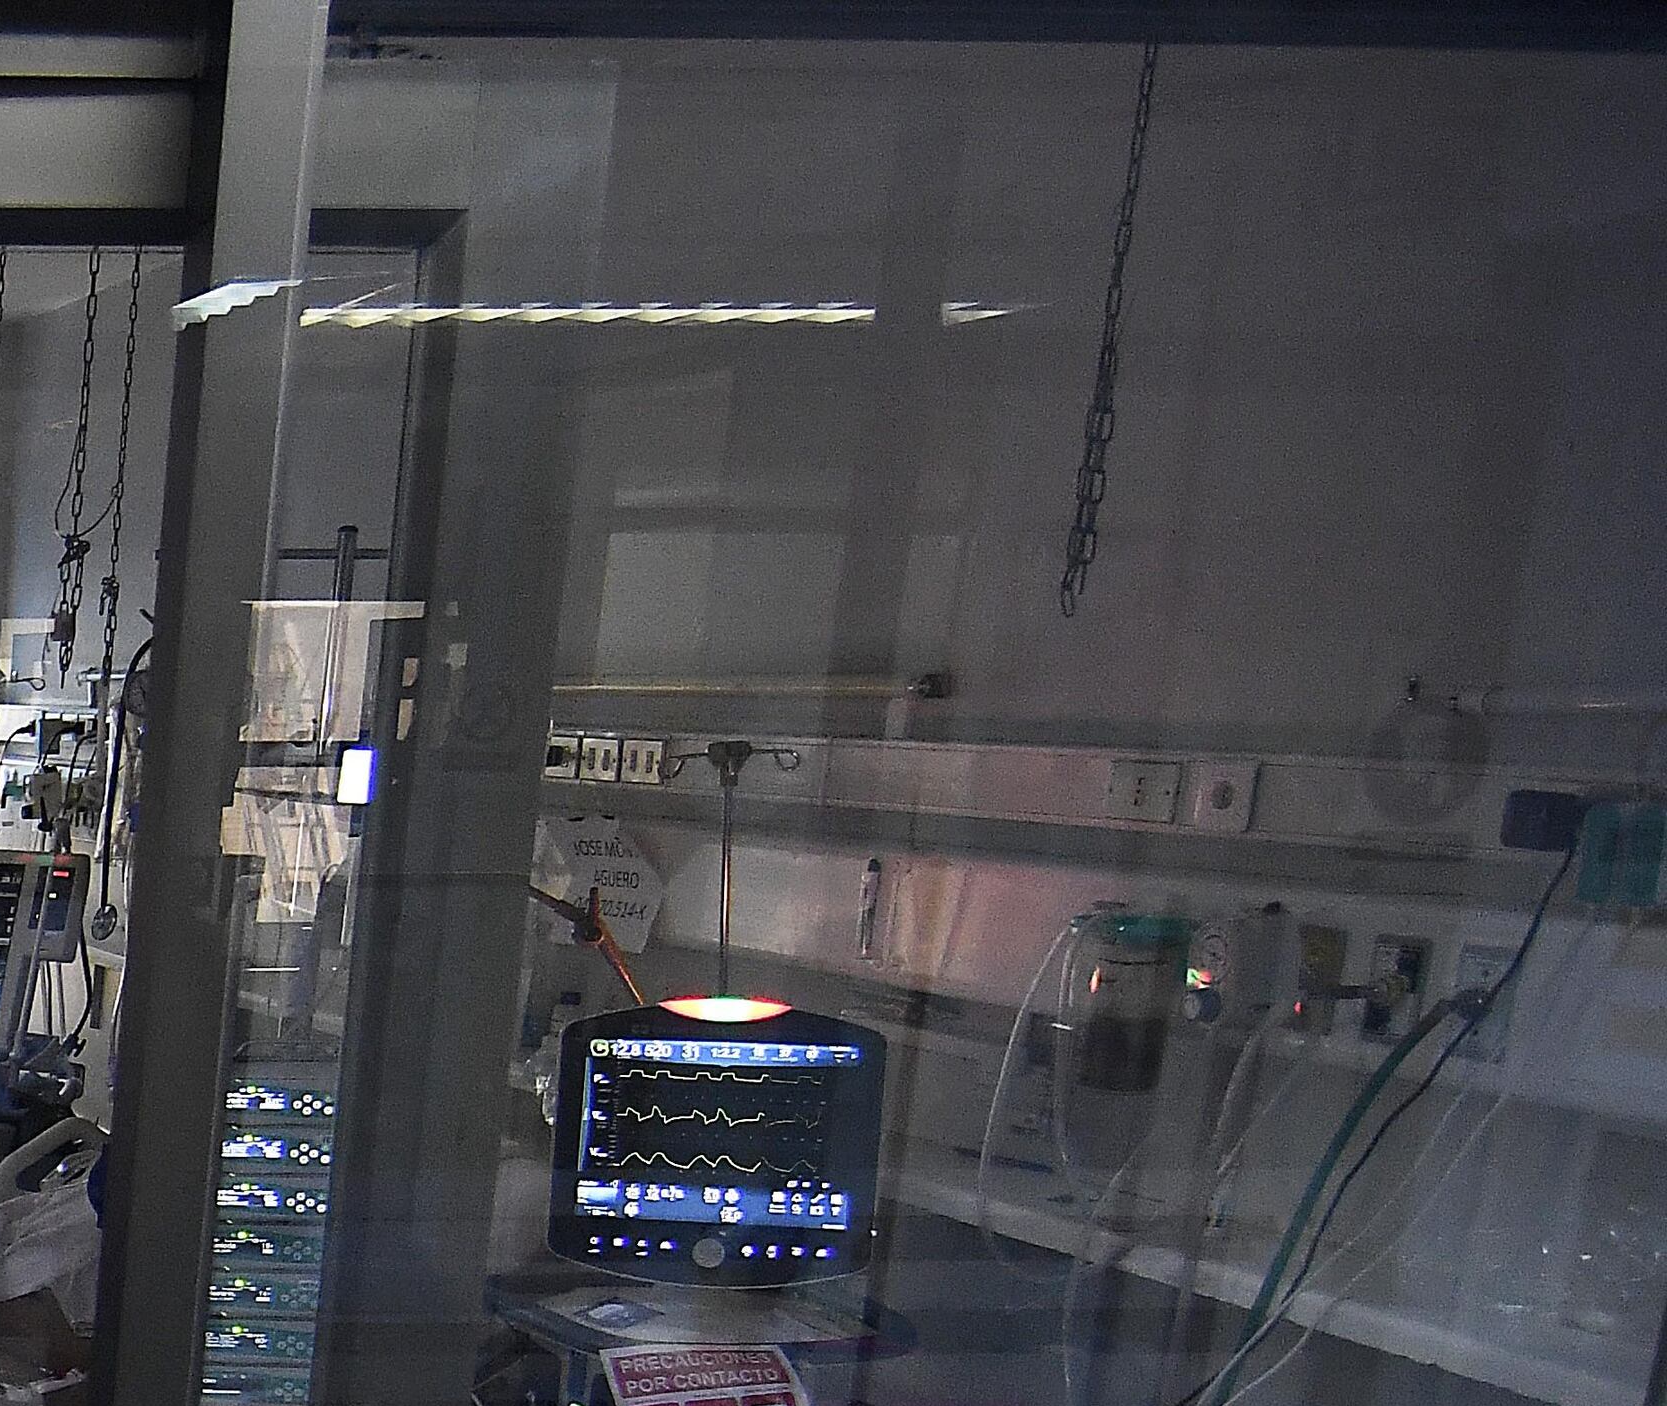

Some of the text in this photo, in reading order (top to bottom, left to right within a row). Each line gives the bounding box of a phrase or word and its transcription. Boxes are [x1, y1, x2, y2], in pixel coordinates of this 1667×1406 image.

[619, 1352, 771, 1375] PRECAUCIONES
[626, 1367, 780, 1395] POR CONTACTO
